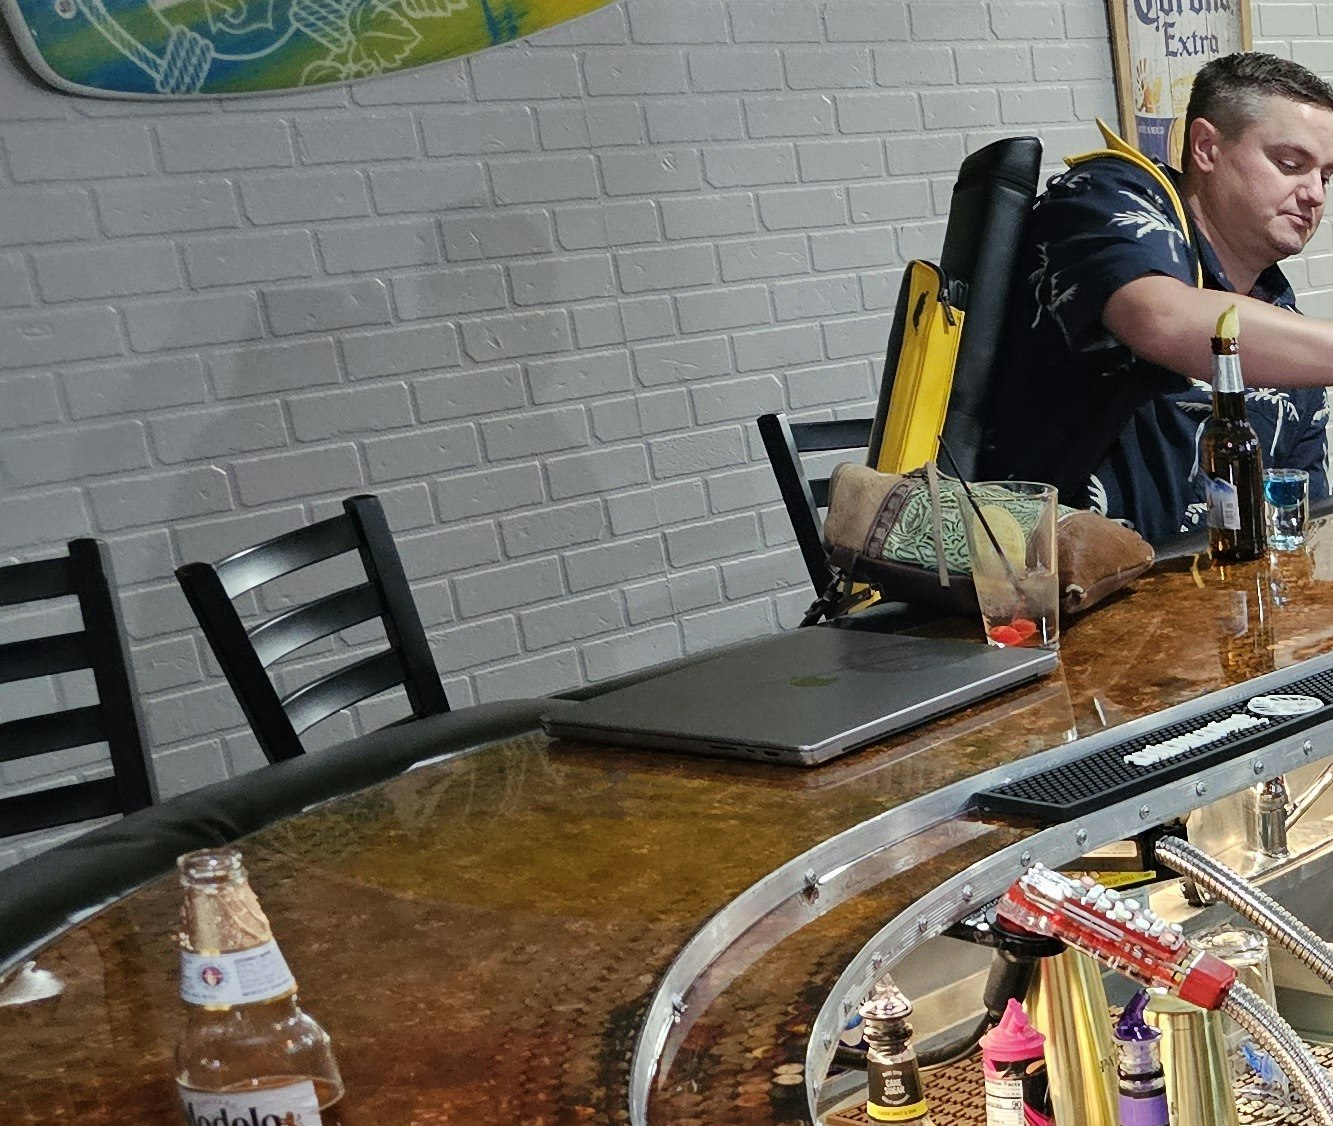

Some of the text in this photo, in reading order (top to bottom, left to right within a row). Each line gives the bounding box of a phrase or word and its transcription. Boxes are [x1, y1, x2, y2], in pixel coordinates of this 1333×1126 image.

[1162, 21, 1219, 57] Extra
[884, 1078, 902, 1088] CANE
[883, 1086, 906, 1096] SUGAR
